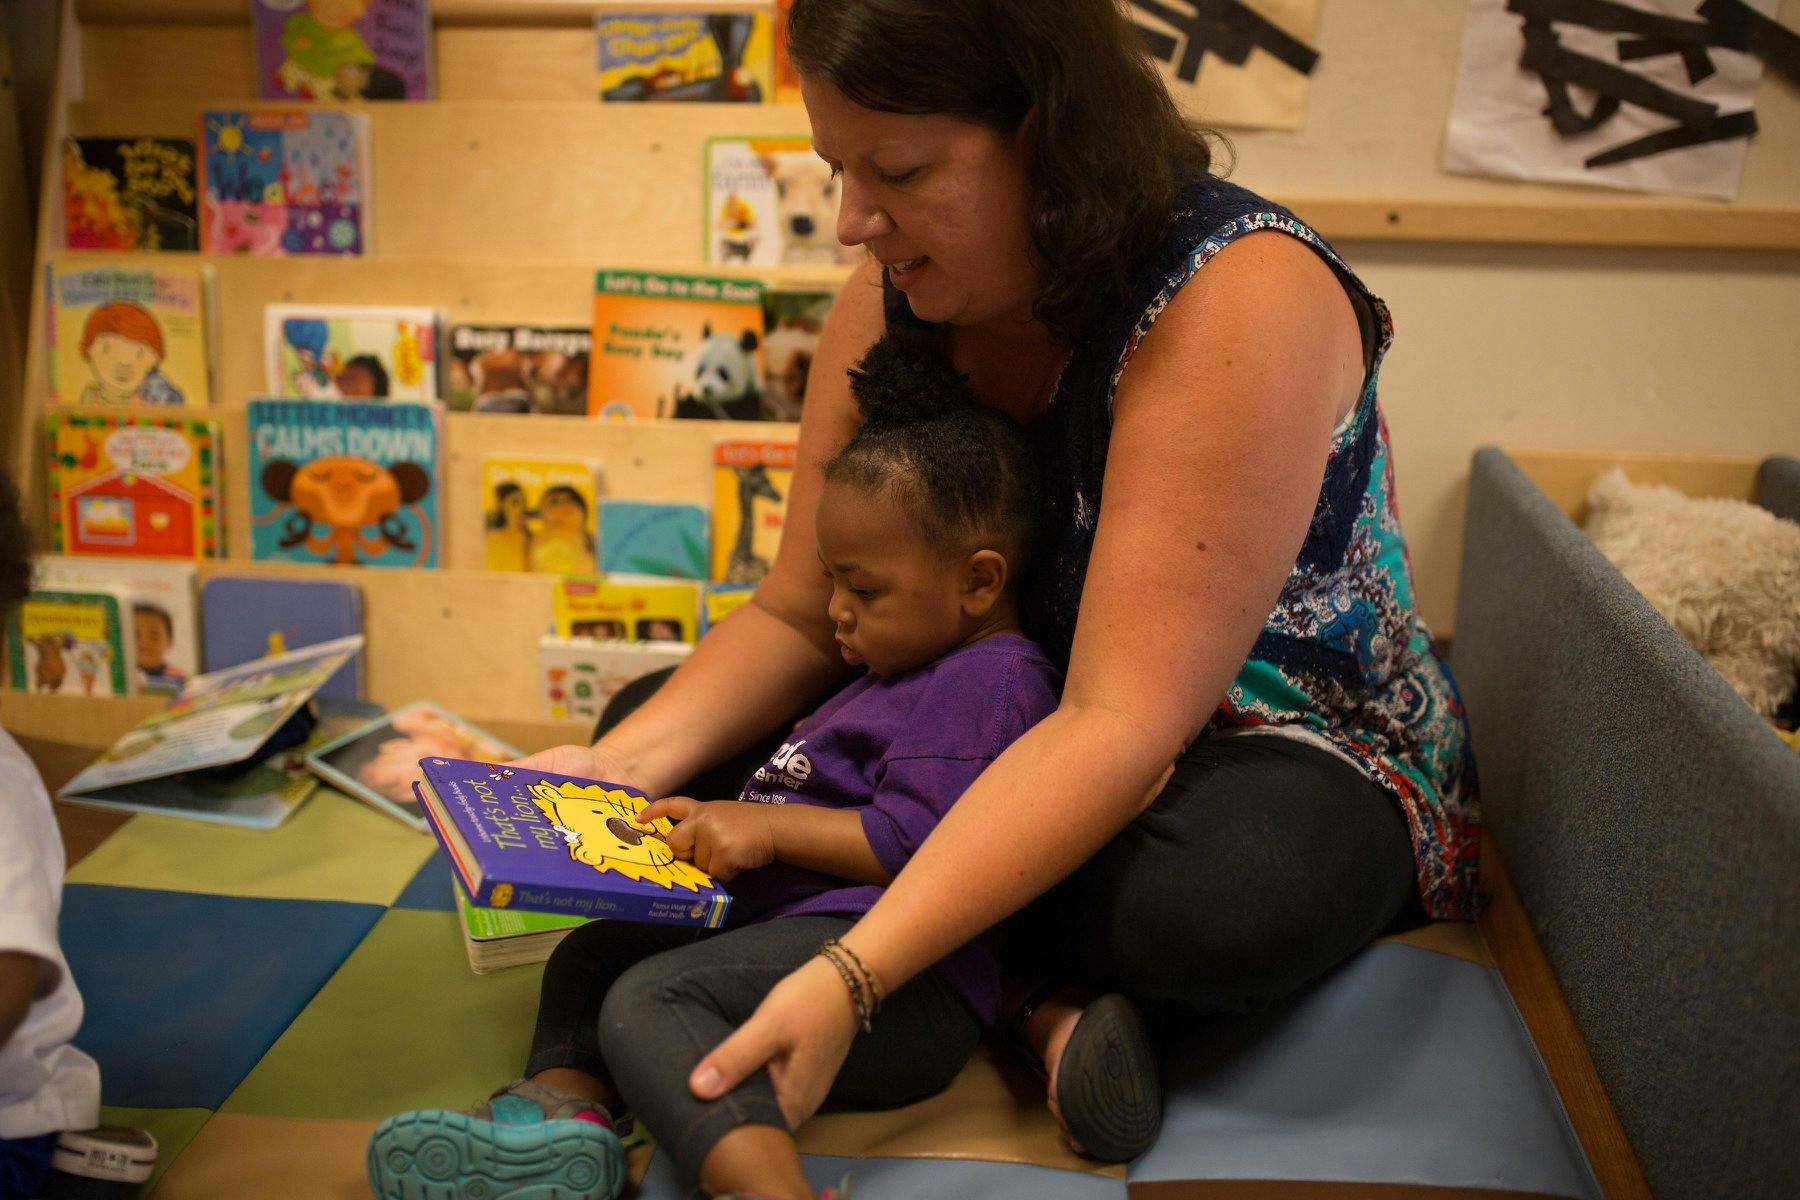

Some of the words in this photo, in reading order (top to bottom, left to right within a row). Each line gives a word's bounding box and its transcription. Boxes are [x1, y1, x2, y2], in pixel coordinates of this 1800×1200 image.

[645, 275, 668, 293] Go
[256, 423, 343, 458] CALMS
[346, 426, 432, 463] DOWN
[771, 740, 811, 779] de
[753, 767, 804, 790] enter
[463, 780, 499, 804] not
[749, 791, 771, 803] Since
[482, 807, 527, 849] That's
[529, 826, 559, 849] my
[520, 891, 551, 905] That's
[553, 896, 573, 906] not
[575, 898, 593, 912] my
